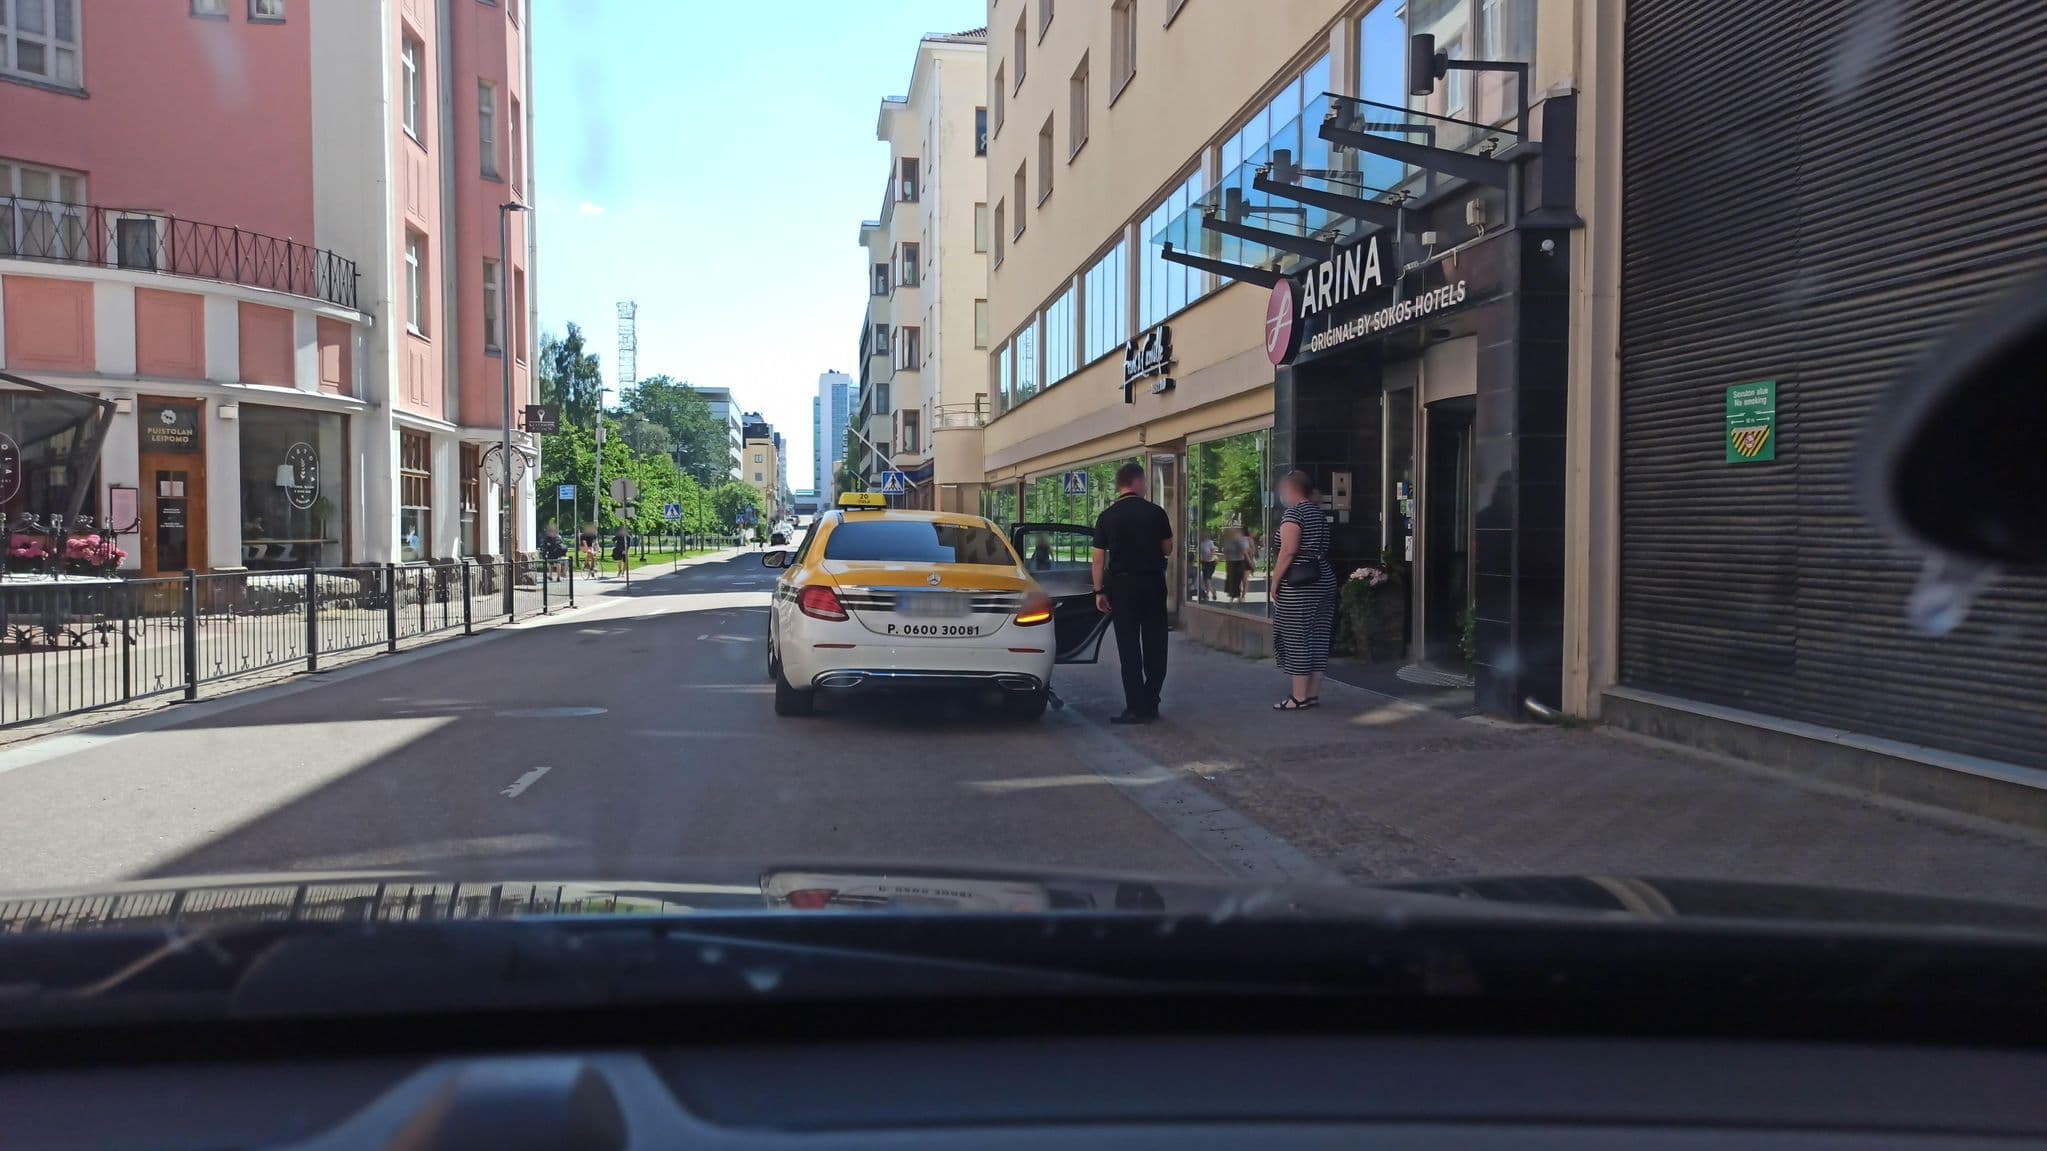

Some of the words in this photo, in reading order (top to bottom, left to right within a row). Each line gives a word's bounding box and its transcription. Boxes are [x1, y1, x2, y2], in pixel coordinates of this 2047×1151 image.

[1301, 236, 1382, 319] ARINA
[1311, 321, 1355, 353] ORIGINAL
[1357, 314, 1373, 337] BY
[1373, 300, 1412, 331] SOKOS
[1415, 280, 1466, 317] HOTELS
[147, 427, 193, 436] PUISTOLAN
[151, 435, 189, 443] LEIPOMO
[887, 624, 898, 634] P.
[904, 625, 938, 635] 0600
[942, 625, 980, 635] 30081
